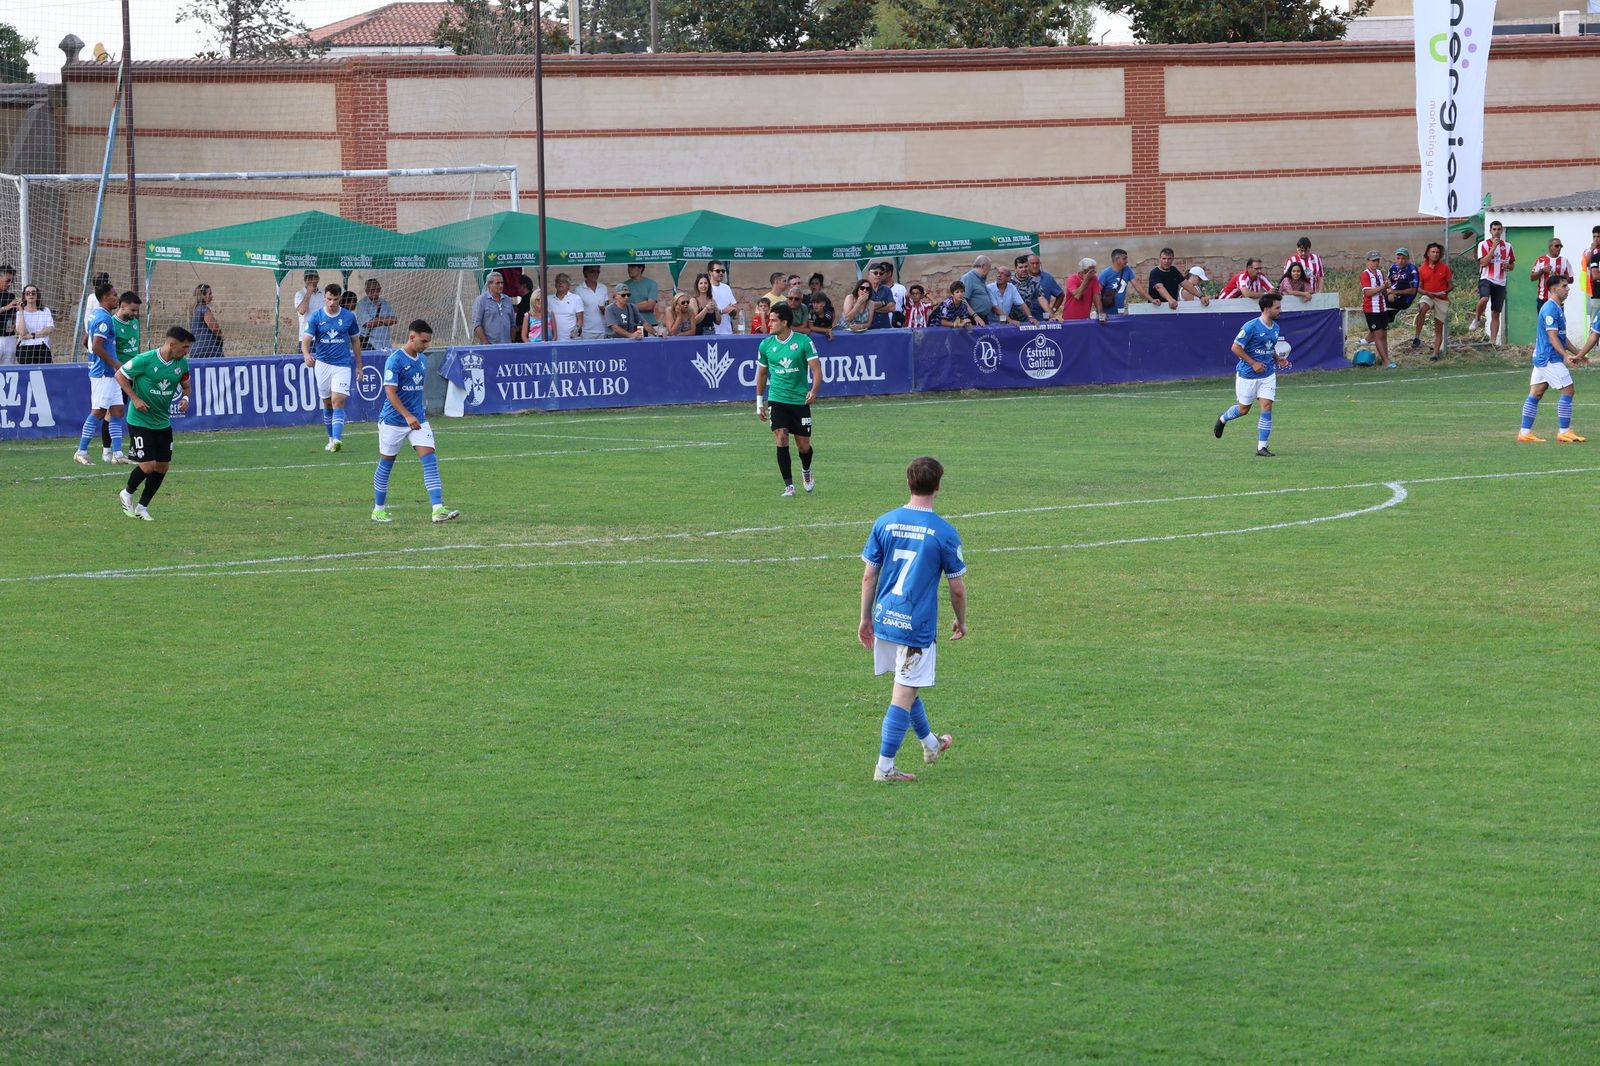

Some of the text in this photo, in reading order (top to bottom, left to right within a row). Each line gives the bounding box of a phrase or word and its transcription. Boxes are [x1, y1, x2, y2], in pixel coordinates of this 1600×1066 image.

[1426, 101, 1437, 157] marketing
[1026, 347, 1056, 357] Estrella
[496, 359, 627, 377] AYUNTAMIENTO DE
[807, 354, 886, 384] URAL
[1028, 358, 1054, 368] Galicia
[362, 374, 376, 382] RF
[194, 362, 324, 416] IMPULSO
[362, 384, 376, 392] EF
[496, 376, 630, 400] VILLARALBO
[134, 436, 144, 449] 10
[927, 528, 935, 536] DE
[891, 549, 917, 596] 7
[882, 617, 912, 630] ZAMORA
